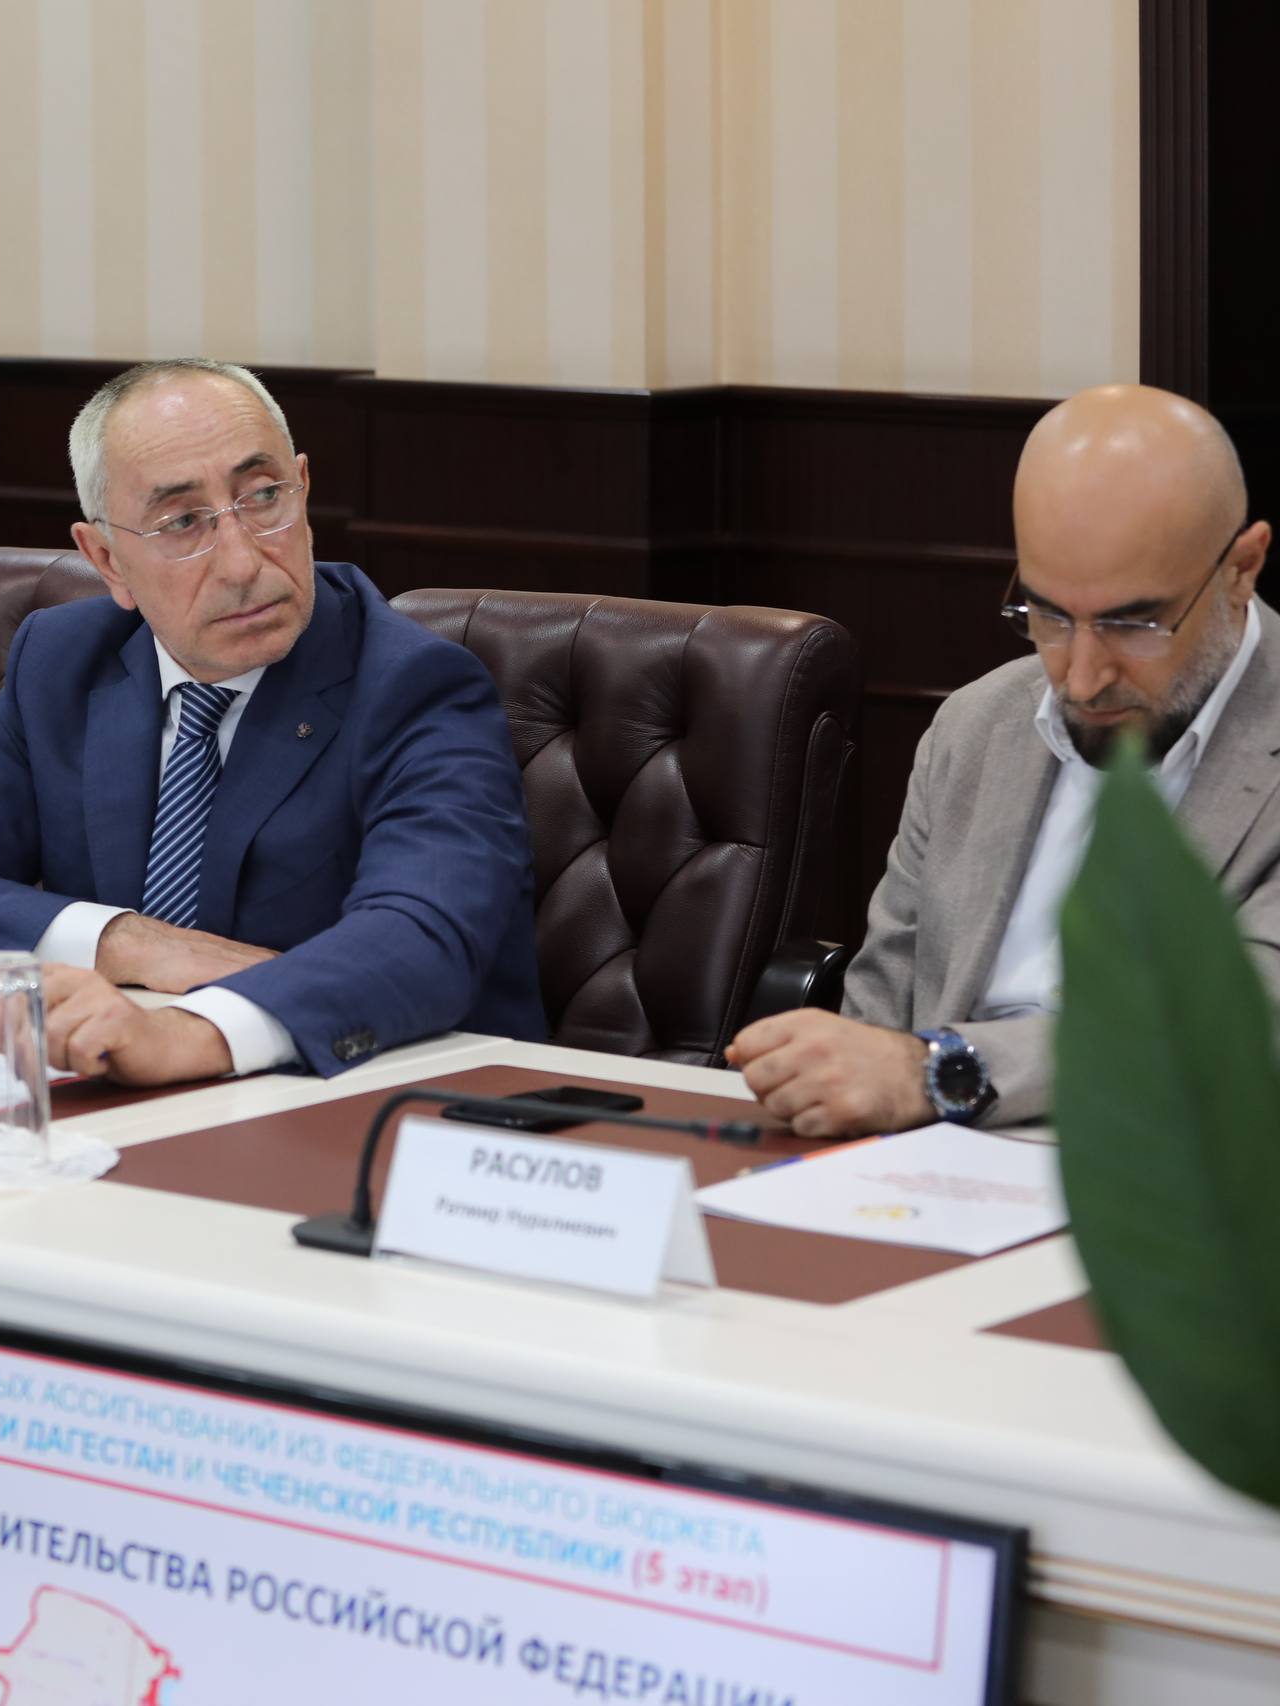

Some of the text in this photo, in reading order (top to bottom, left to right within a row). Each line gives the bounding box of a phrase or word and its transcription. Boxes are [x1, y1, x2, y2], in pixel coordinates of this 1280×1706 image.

[470, 1147, 604, 1192] РАСУЛОВ
[24, 1419, 176, 1475] ДАГЕСТАН
[212, 1460, 401, 1524] ЧЕЧЕНСКОЙ
[407, 1503, 622, 1575] РЕСПУБЛИКИ
[631, 1549, 666, 1590] (5
[675, 1562, 769, 1614] этап)
[42, 1378, 279, 1456] АССИГНОВАНИЙ
[284, 1433, 326, 1467] ИЗ
[333, 1440, 589, 1523] ФЕДЕРАЛЬНОГО
[594, 1495, 768, 1558] БЮДЖЕТА
[227, 1566, 504, 1667] РОССИЙСКОЙ
